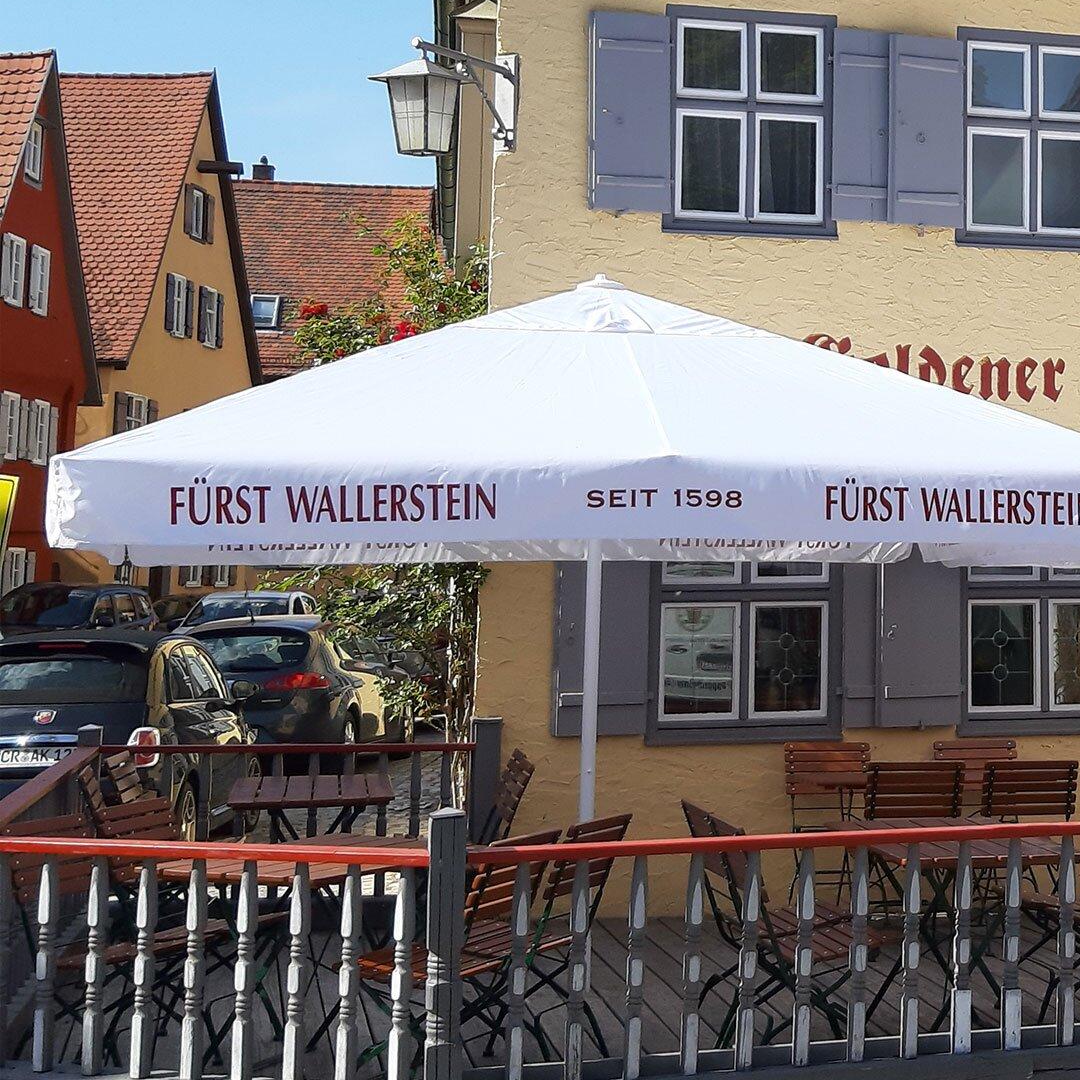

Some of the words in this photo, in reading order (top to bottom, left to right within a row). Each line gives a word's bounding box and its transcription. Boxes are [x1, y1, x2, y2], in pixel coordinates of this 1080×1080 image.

[803, 333, 1066, 402] ldener
[170, 476, 271, 526] FÜRST
[285, 483, 497, 524] WALLERSTEIN
[586, 488, 659, 509] SEIT
[673, 488, 743, 509] 1598
[825, 477, 910, 523] FÜRST
[0, 749, 19, 763] CR
[30, 748, 49, 763] AK
